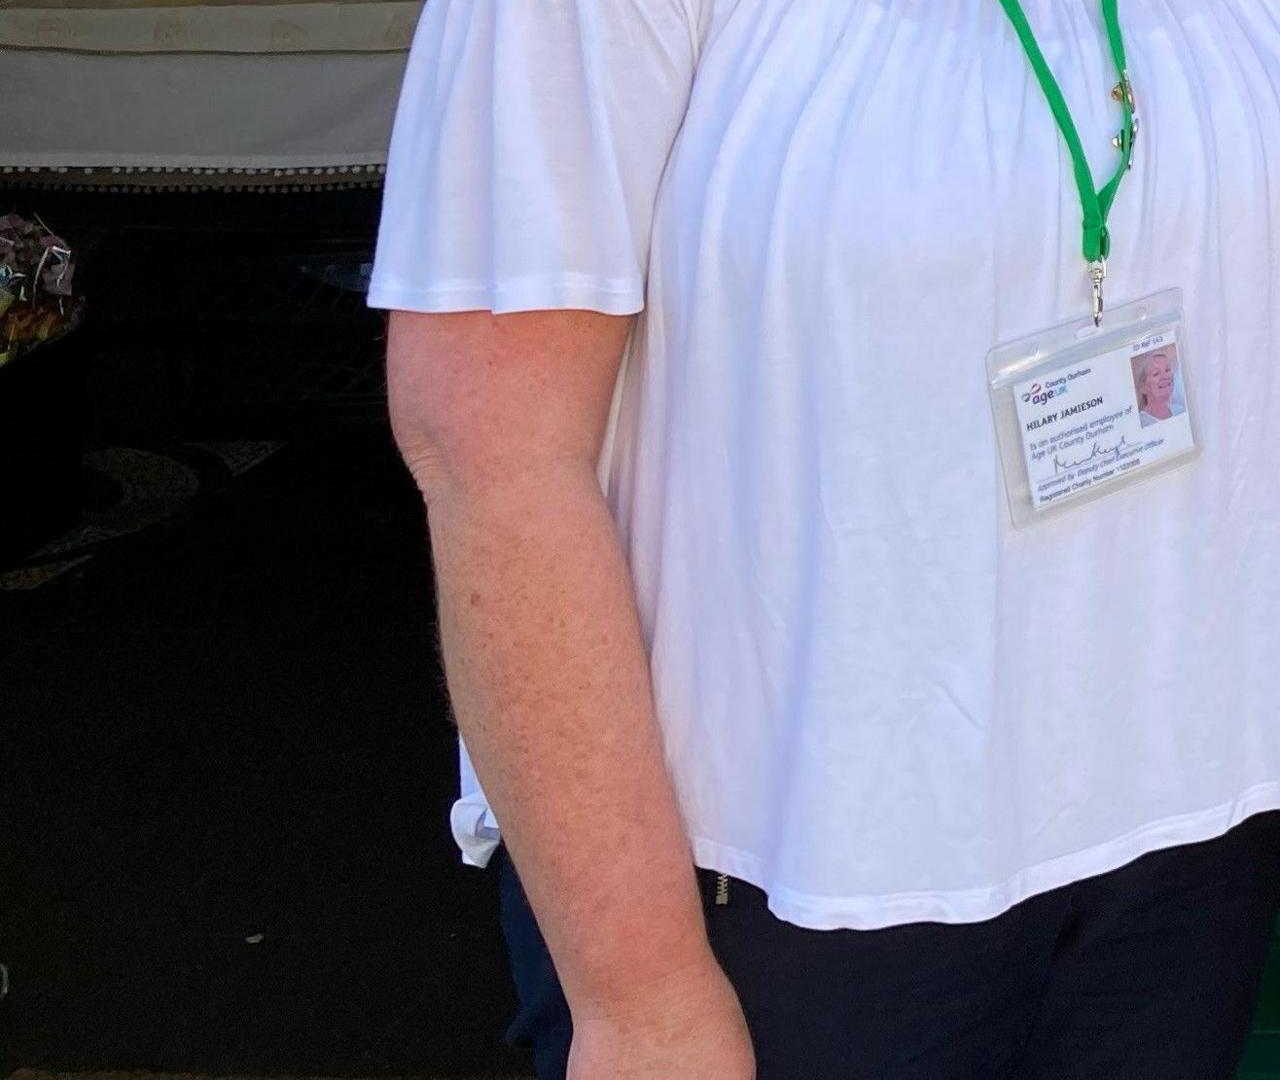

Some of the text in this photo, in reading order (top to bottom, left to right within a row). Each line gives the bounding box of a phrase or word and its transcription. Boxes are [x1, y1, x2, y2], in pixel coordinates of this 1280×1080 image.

[1045, 375, 1067, 388] County
[1026, 396, 1104, 431] HILARY JAMIESON
